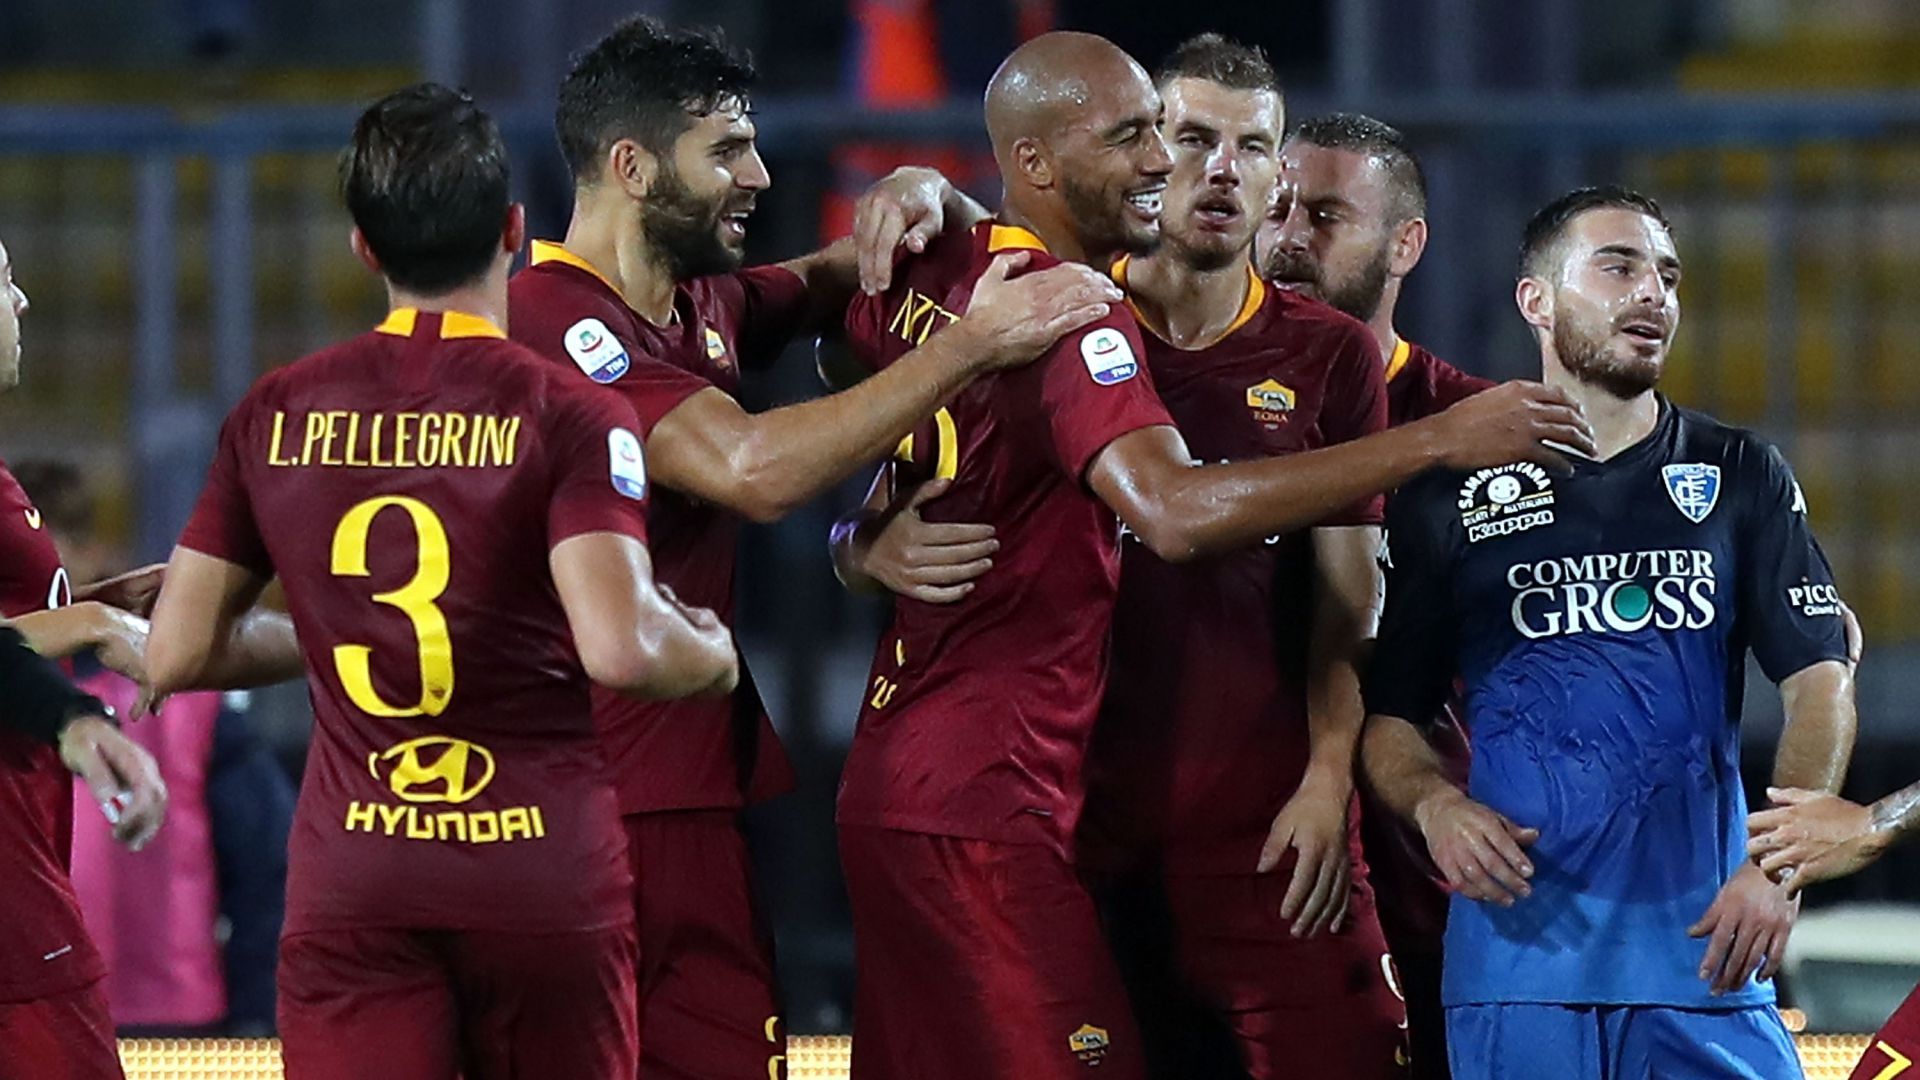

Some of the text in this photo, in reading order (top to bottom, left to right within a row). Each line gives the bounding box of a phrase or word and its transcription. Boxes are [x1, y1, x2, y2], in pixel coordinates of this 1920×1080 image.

[267, 411, 521, 468] L.PELLEGRINI
[1468, 509, 1555, 543] Kappa
[1506, 549, 1715, 590] COMPUTER
[331, 495, 455, 718] 3
[1511, 576, 1716, 640] GROSS
[344, 801, 546, 845] HYUNDAI
